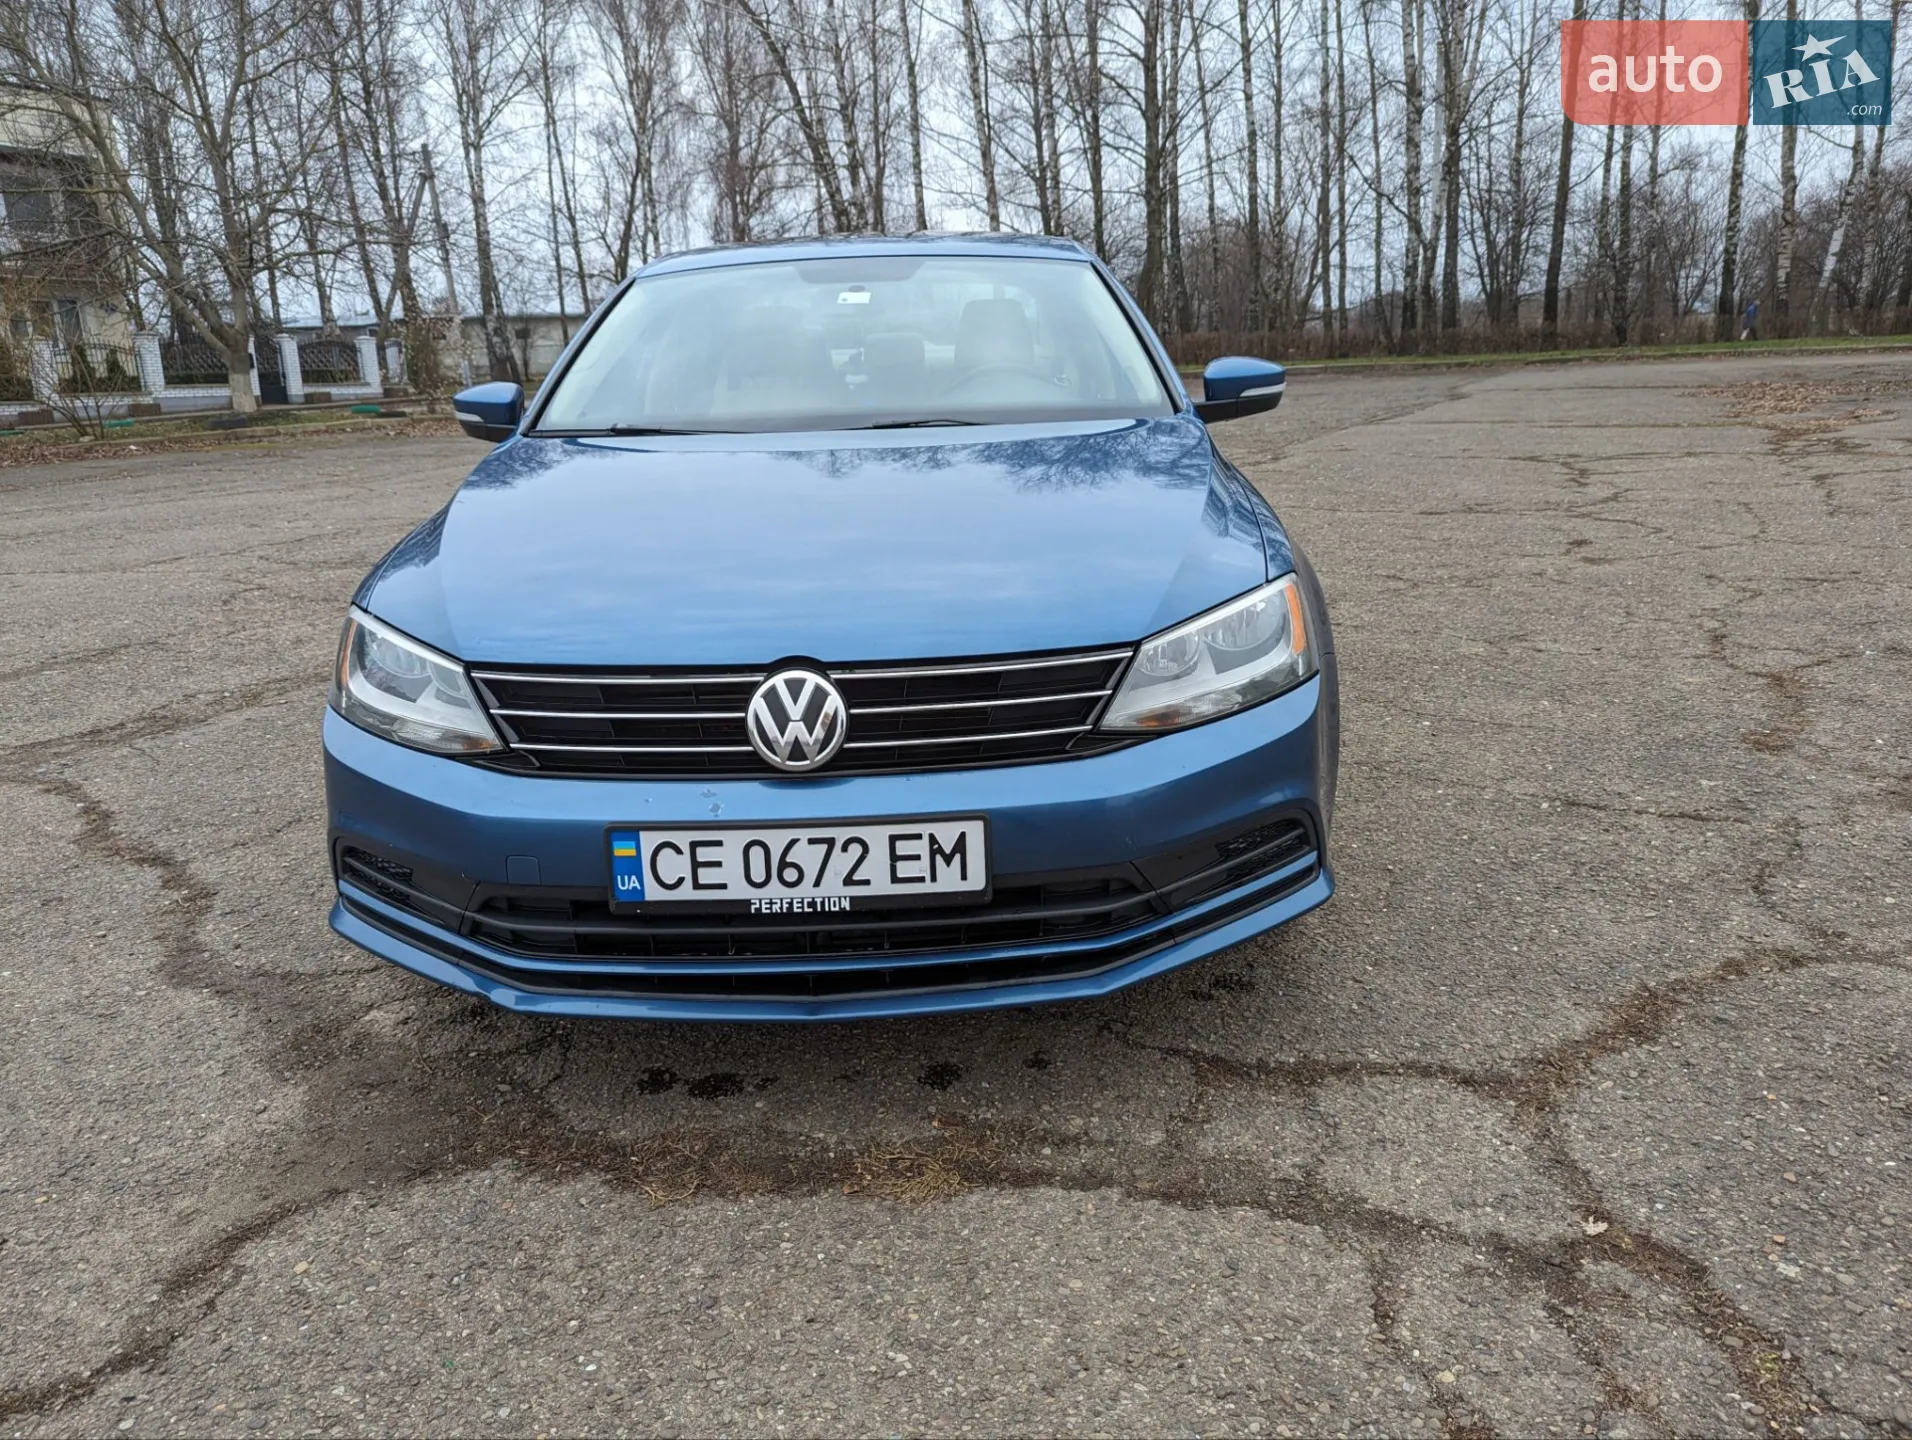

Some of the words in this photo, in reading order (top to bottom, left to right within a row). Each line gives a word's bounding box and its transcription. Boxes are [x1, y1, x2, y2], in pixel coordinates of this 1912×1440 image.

[649, 839, 728, 890] CE
[743, 836, 871, 889] 0672
[888, 830, 968, 884] EM
[617, 875, 641, 891] UA
[750, 896, 851, 914] PERFECTION
